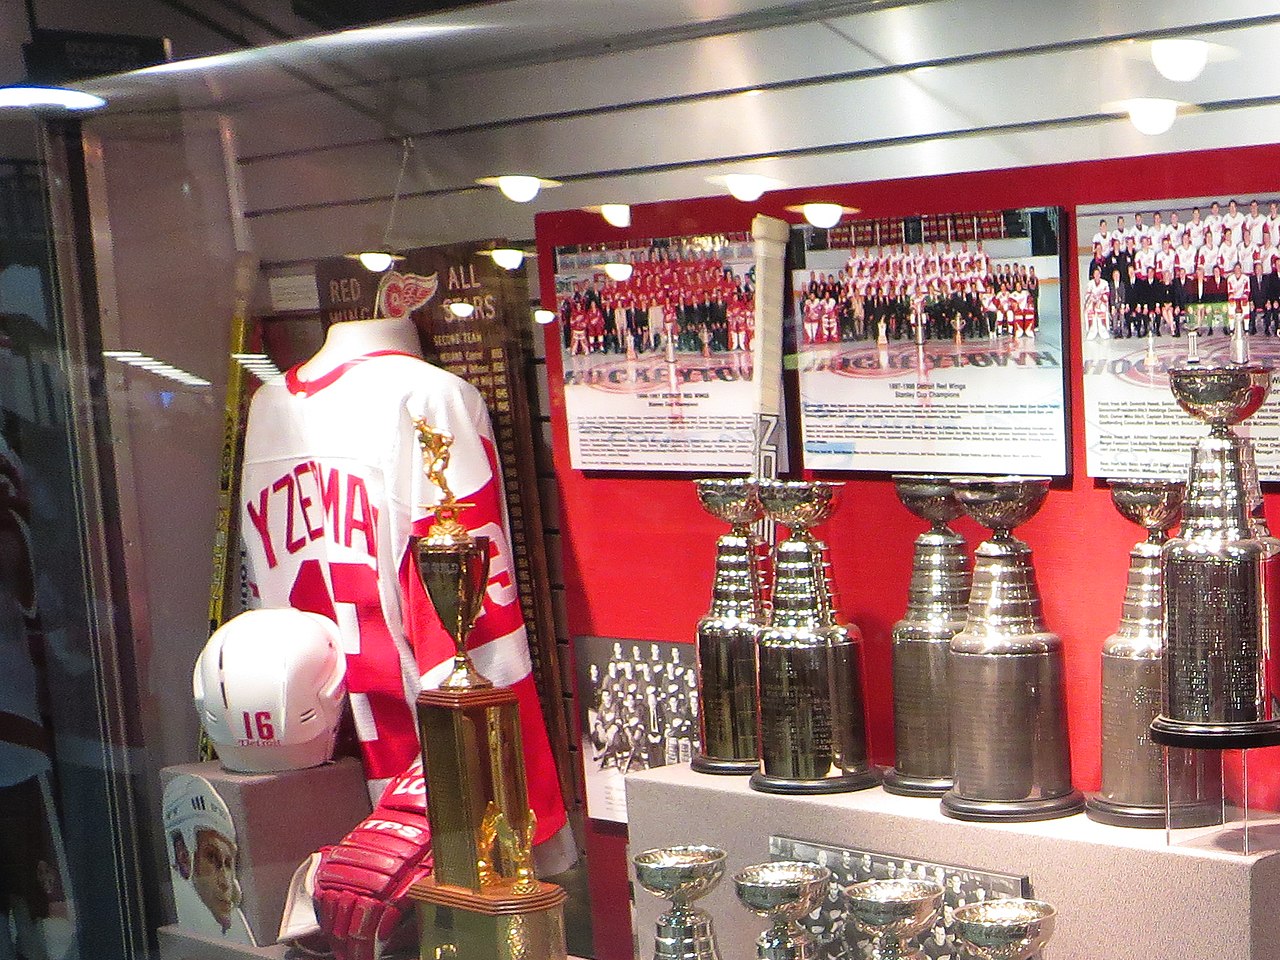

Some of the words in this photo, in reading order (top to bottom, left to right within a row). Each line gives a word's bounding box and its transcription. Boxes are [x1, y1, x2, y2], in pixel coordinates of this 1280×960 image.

[448, 264, 481, 290] ALL
[329, 278, 361, 303] RED
[895, 391, 915, 399] Stanley
[916, 391, 928, 399] Cup
[949, 383, 966, 391] Wings
[243, 711, 274, 739] 16
